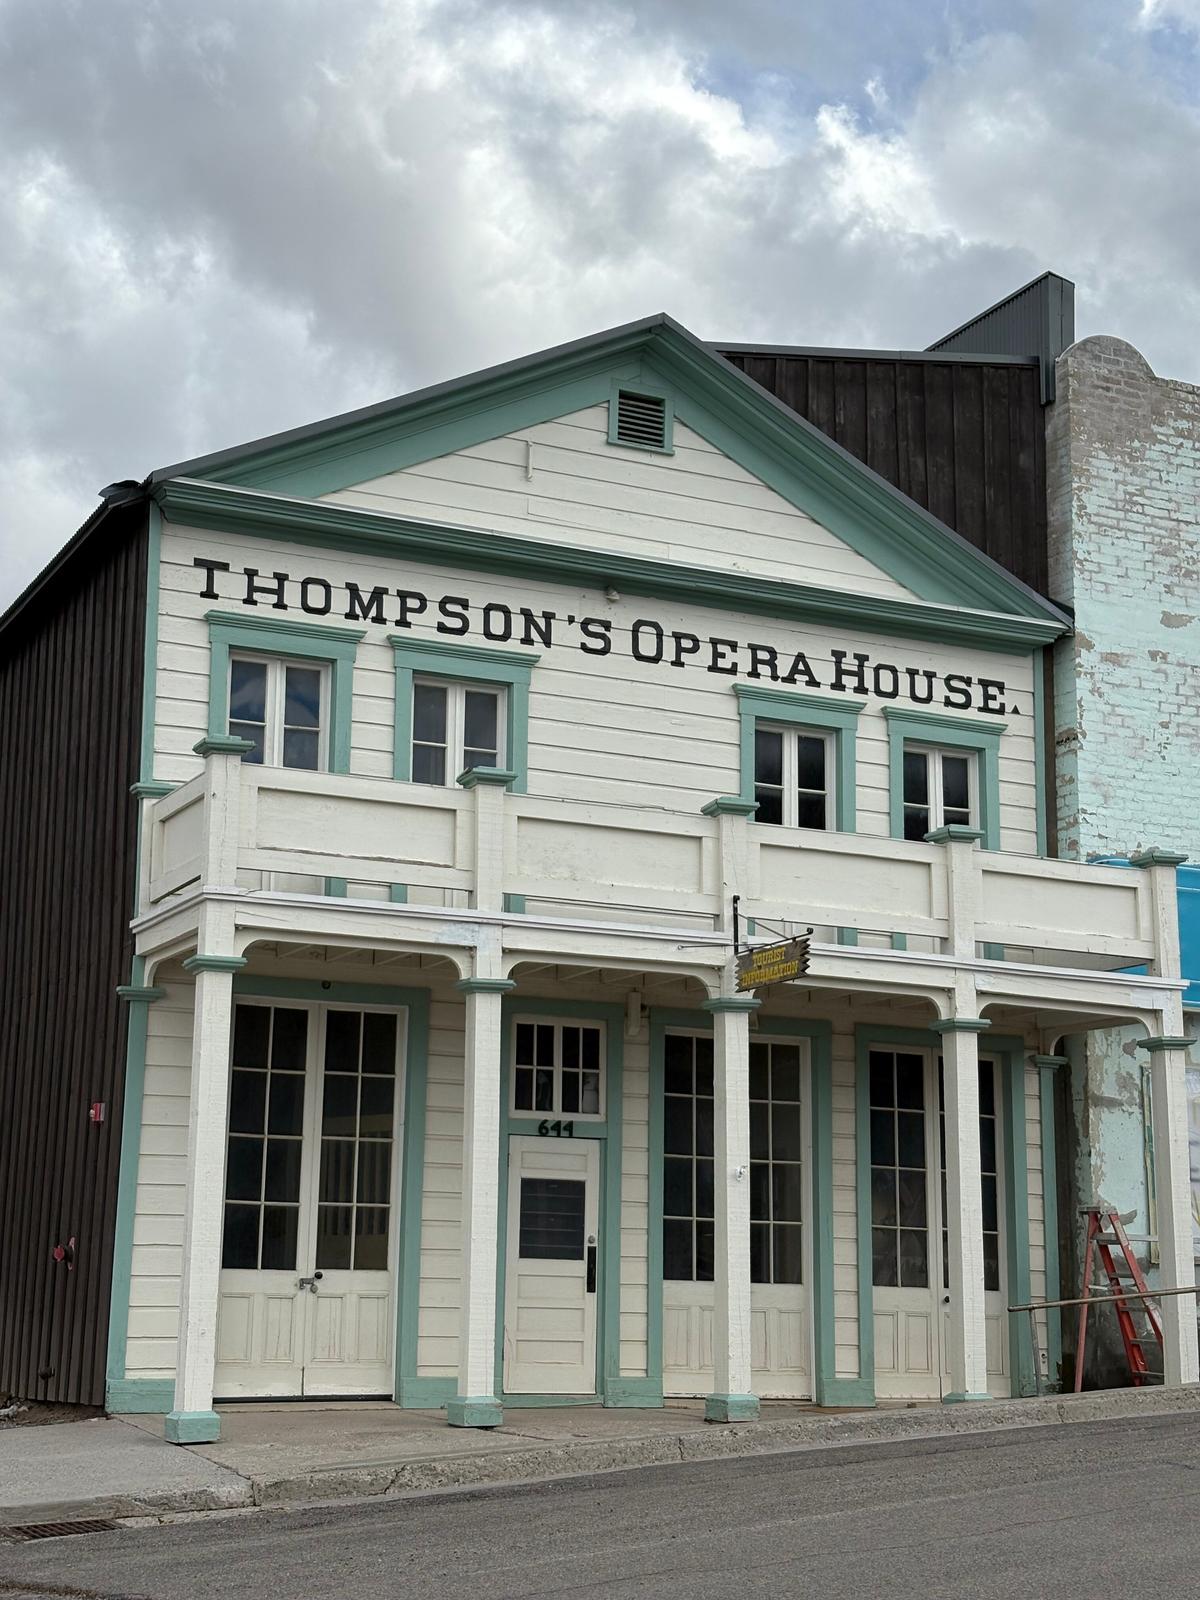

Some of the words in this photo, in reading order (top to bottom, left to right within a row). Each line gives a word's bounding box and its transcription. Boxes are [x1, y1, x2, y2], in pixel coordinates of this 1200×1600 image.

[193, 557, 612, 656] THOMPSON'S
[631, 619, 821, 688] OPERA
[752, 946, 786, 968] TOURIST
[741, 960, 799, 987] INFORMATION
[538, 1119, 573, 1137] 644
